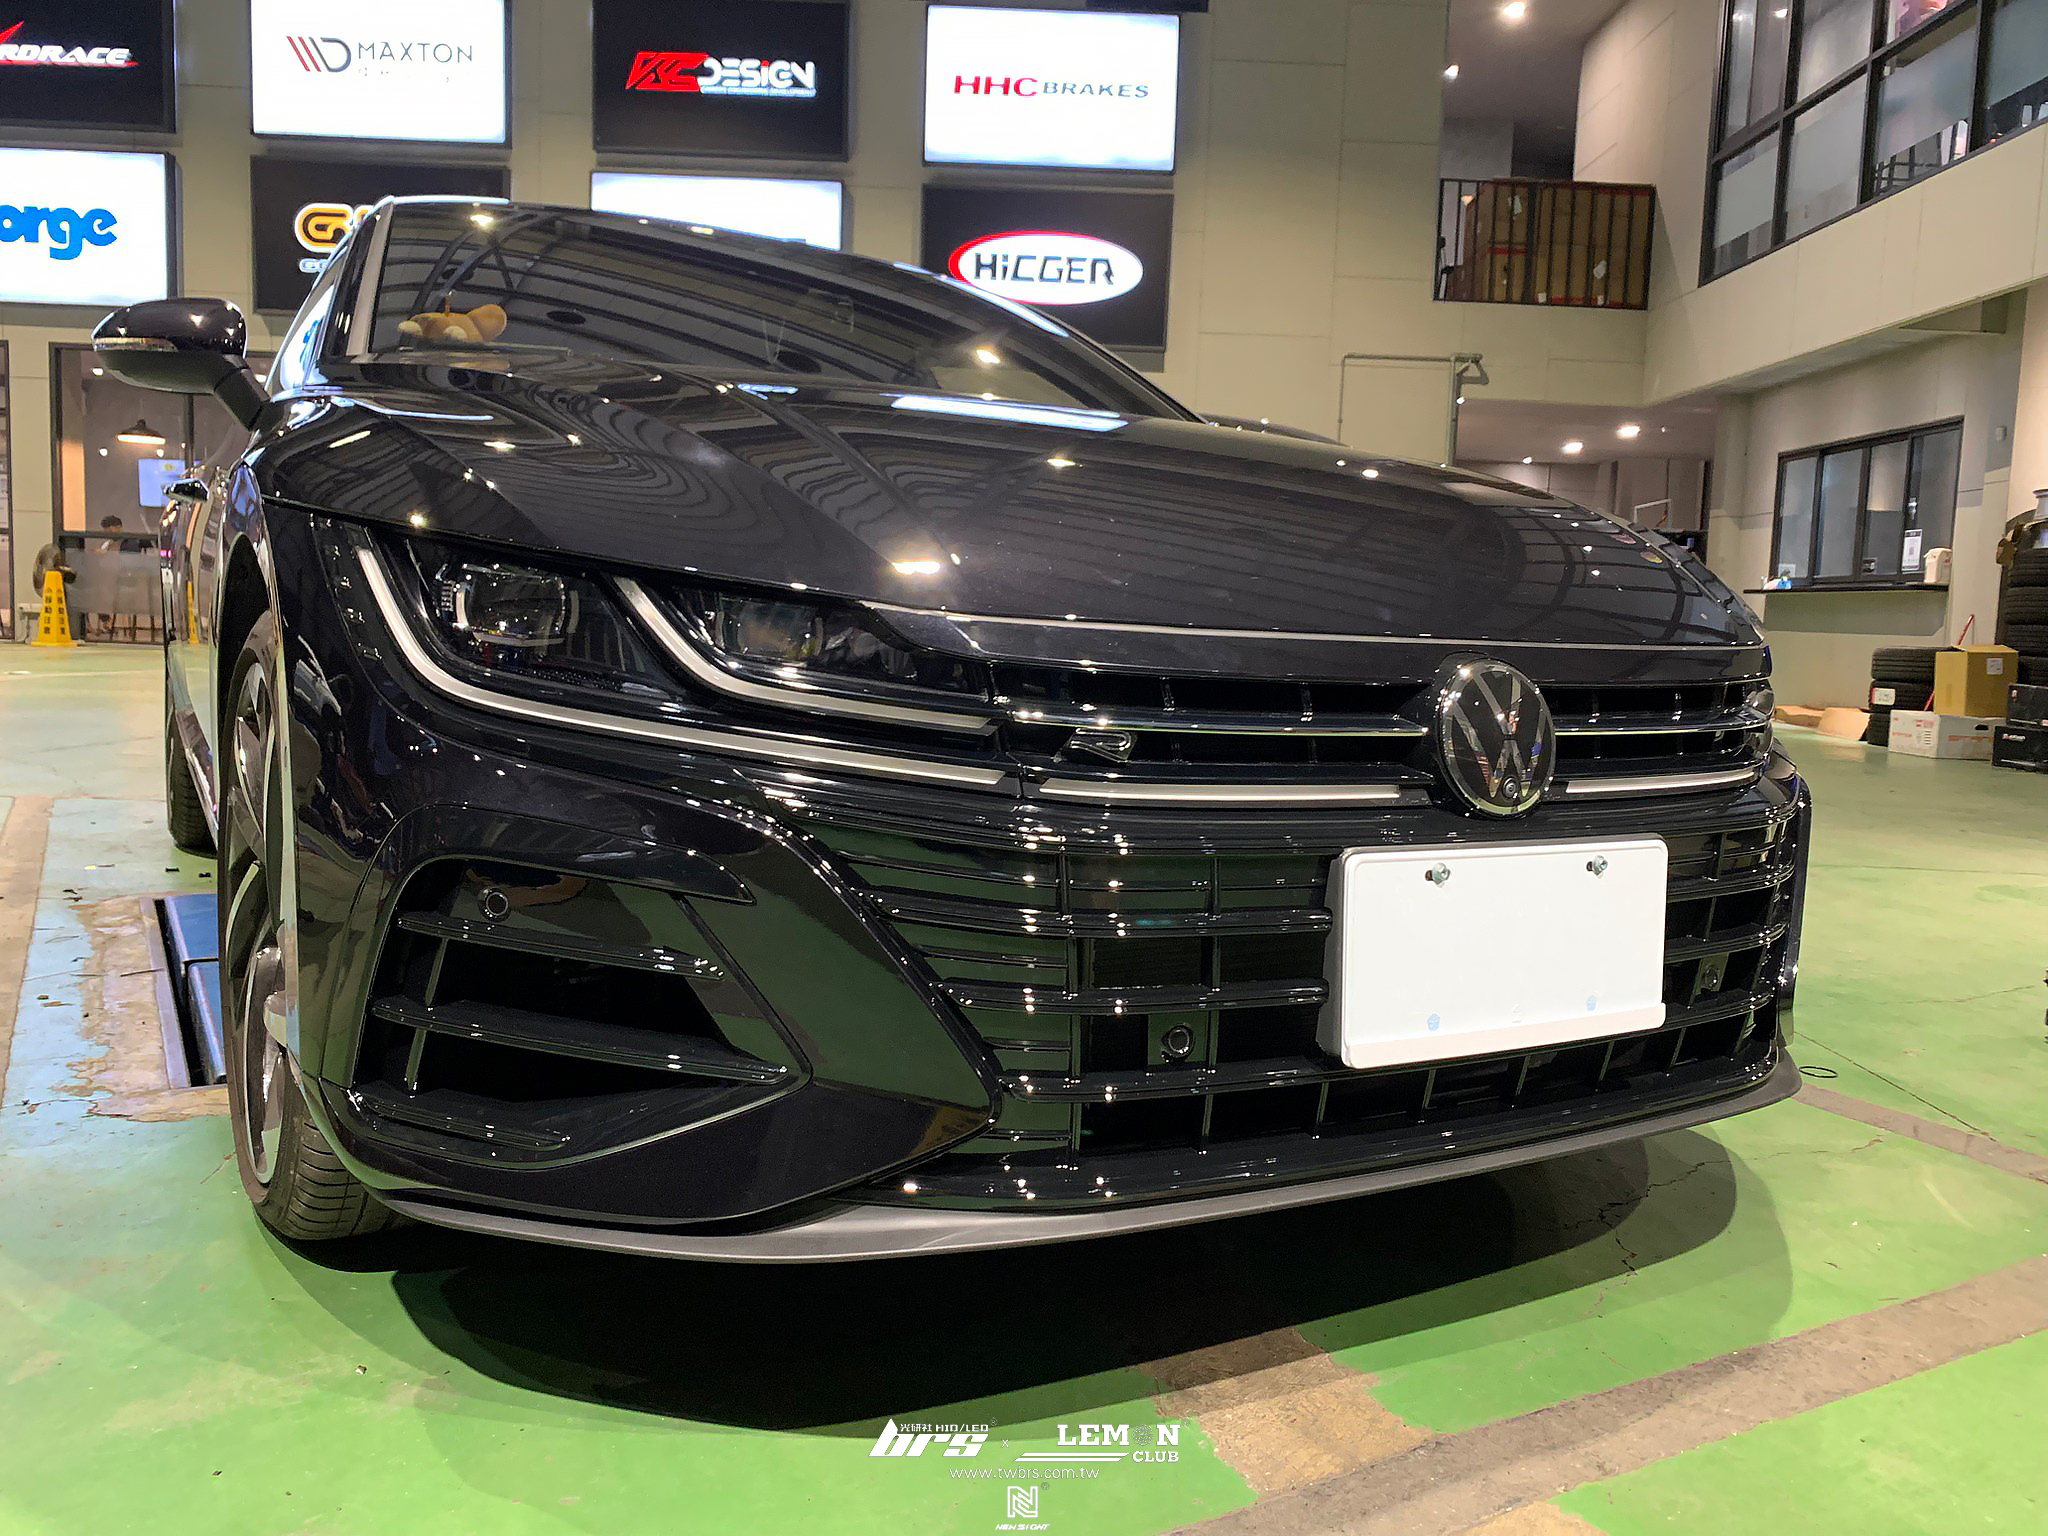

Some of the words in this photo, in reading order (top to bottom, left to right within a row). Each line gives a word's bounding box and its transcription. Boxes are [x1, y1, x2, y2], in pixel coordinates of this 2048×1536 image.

[358, 42, 472, 63] MAXTON
[954, 75, 1038, 97] HHC
[1043, 81, 1149, 98] BRAKES
